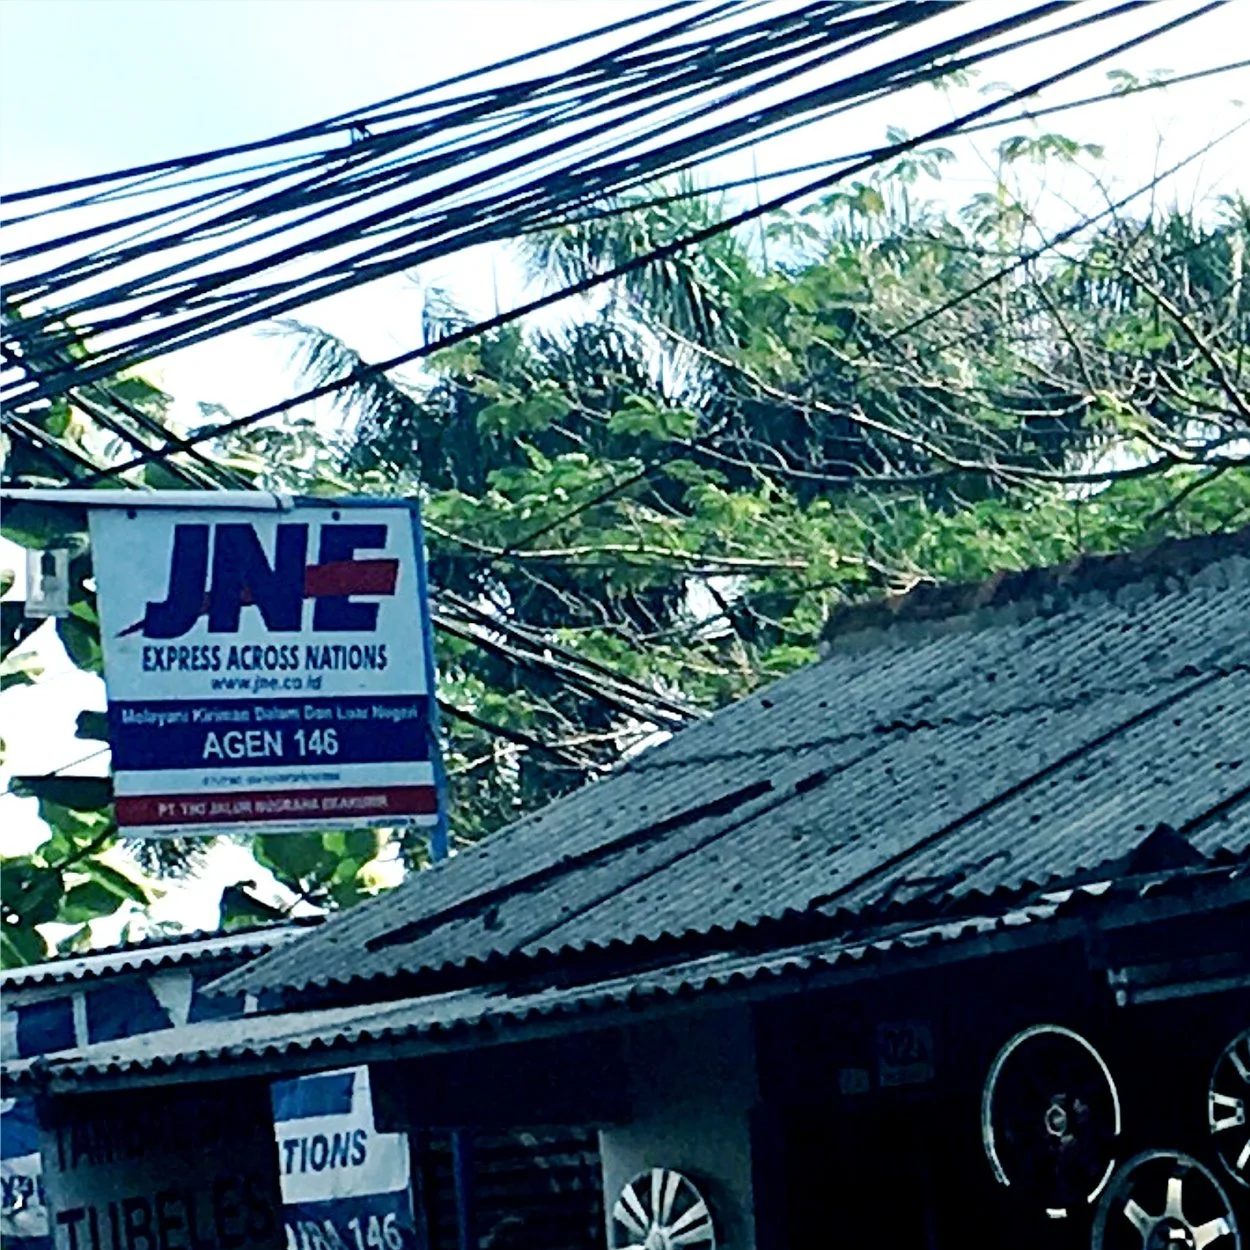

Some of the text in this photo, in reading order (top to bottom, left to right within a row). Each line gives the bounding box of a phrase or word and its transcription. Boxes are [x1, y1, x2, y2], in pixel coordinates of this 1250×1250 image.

[115, 522, 399, 638] JNE
[142, 644, 388, 672] EXPRESS ACROSS NATIONS
[210, 675, 323, 694] www.jne.co.id
[202, 728, 340, 759] AGEN 146
[282, 1128, 368, 1175] TIONS
